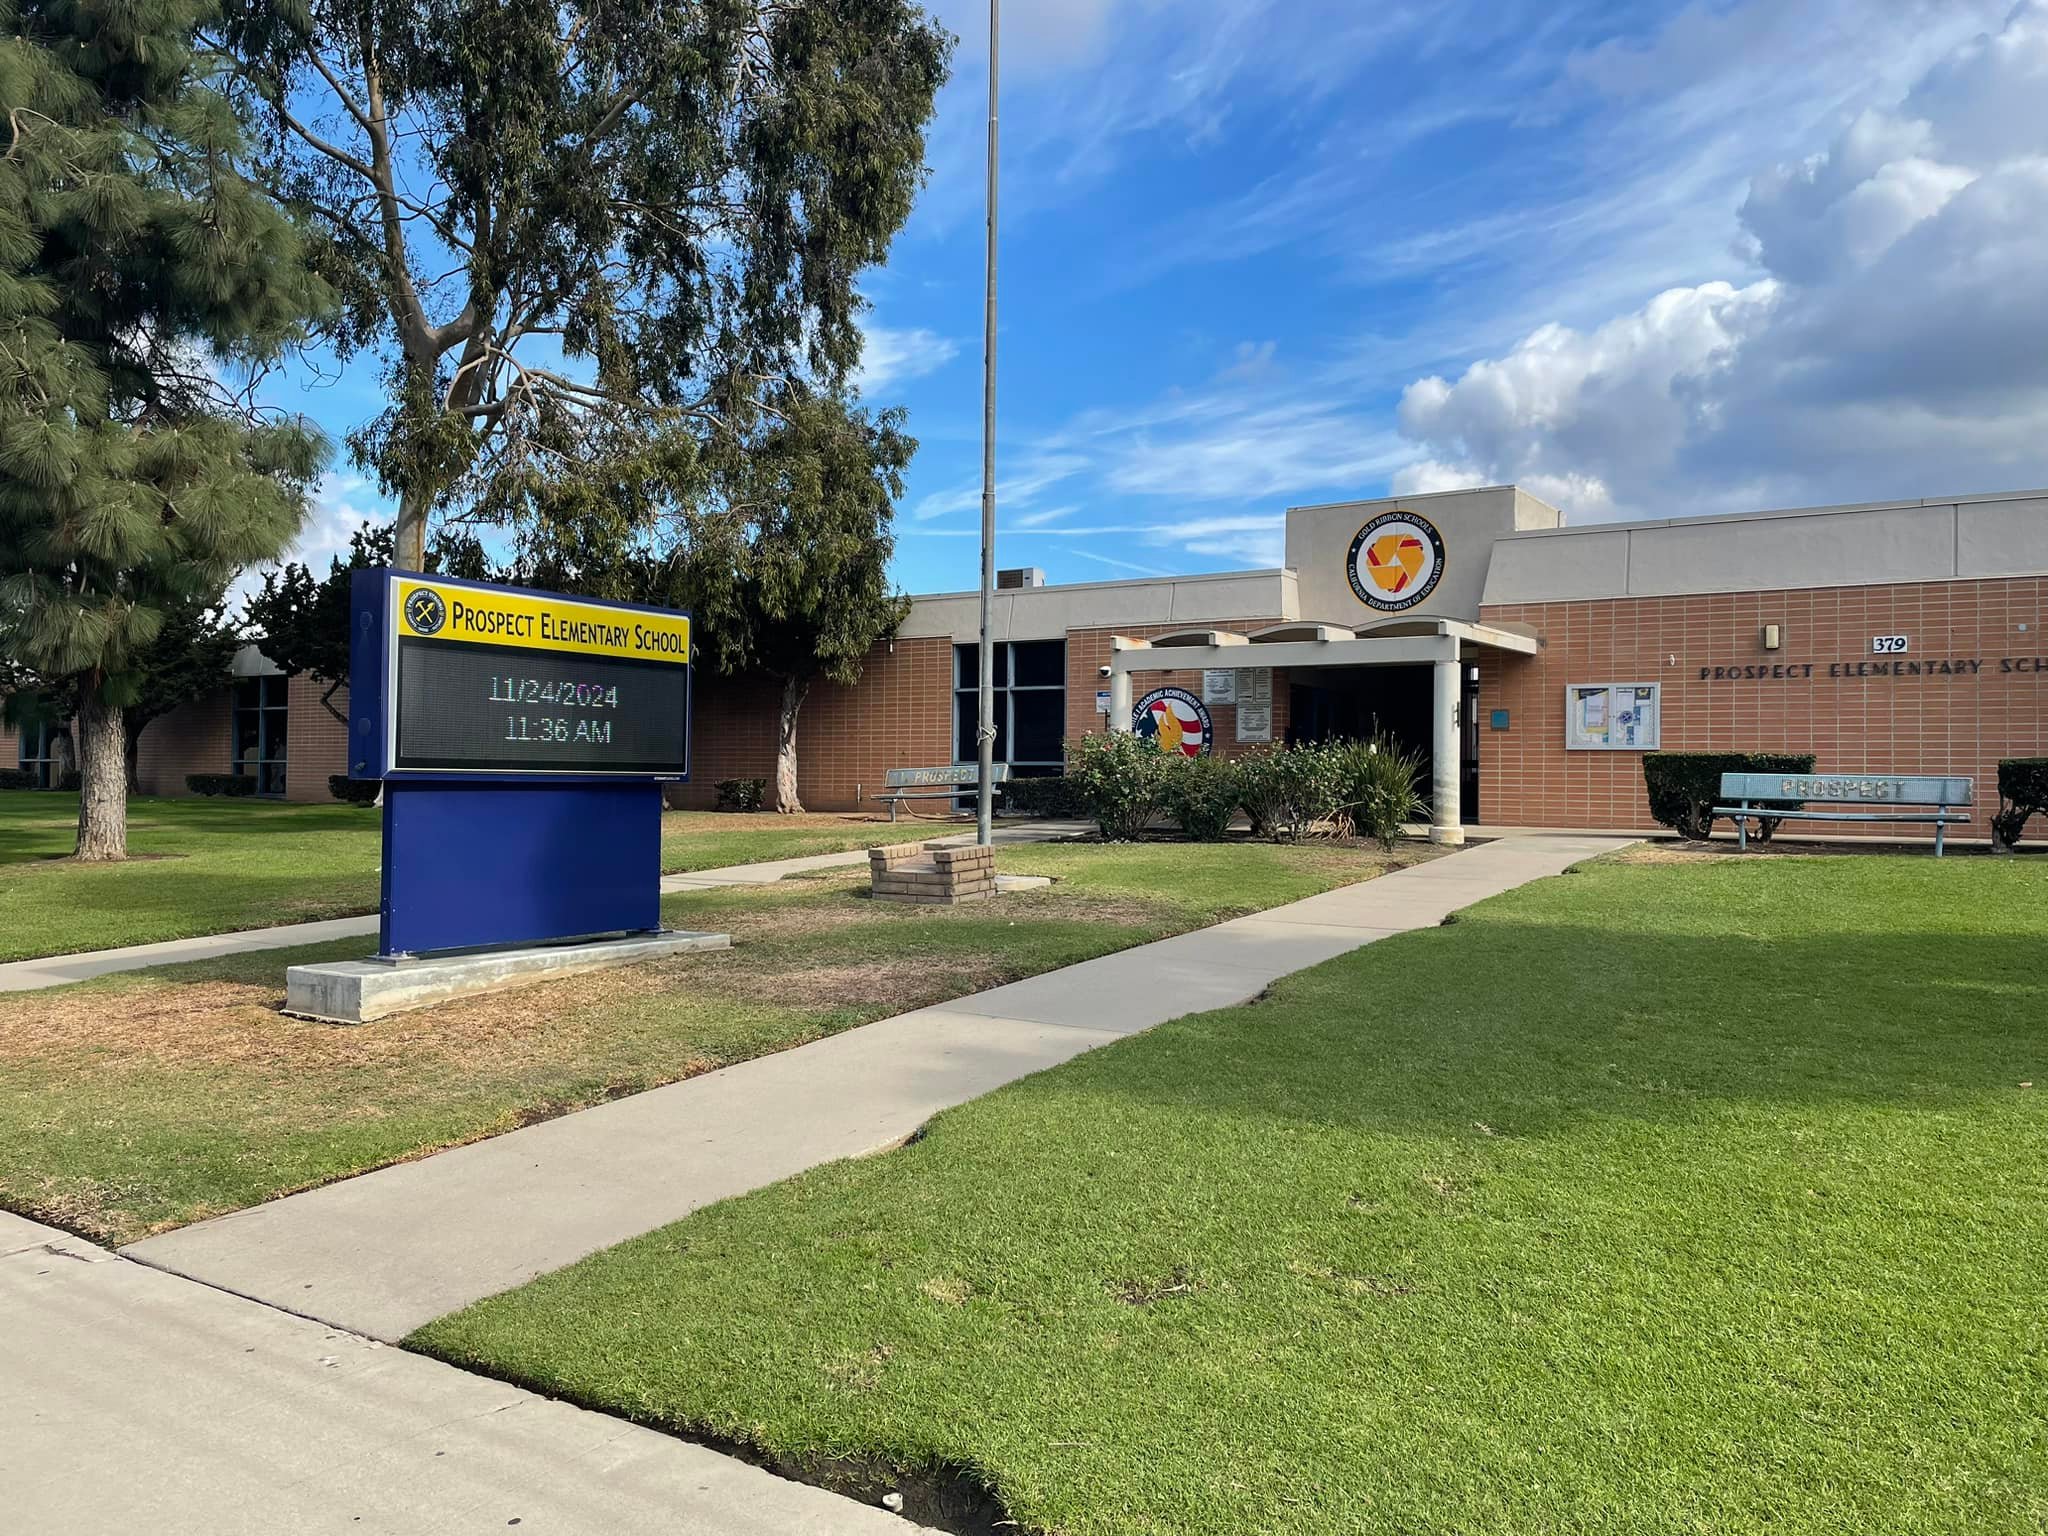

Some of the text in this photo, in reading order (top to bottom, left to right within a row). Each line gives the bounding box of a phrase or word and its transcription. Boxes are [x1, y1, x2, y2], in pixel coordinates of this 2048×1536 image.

[1358, 513, 1434, 540] GOLD RIBBON SCHOOLS
[1348, 563, 1368, 601] CALIFORNIA
[1368, 598, 1412, 610] DEPARTMENT
[1421, 558, 1442, 596] EDUCATION
[1874, 637, 1907, 652] 379
[1700, 656, 2048, 680] PROSPECT ELEMENTARY SCH
[488, 676, 618, 709] 11/24/2024
[1138, 690, 1164, 714] ACADEMIC
[1164, 689, 1200, 710] ACHIEVEMENT
[1196, 707, 1210, 728] AWARD
[505, 716, 612, 744] 11:36 AM
[1782, 779, 1905, 799] PROSPECT
